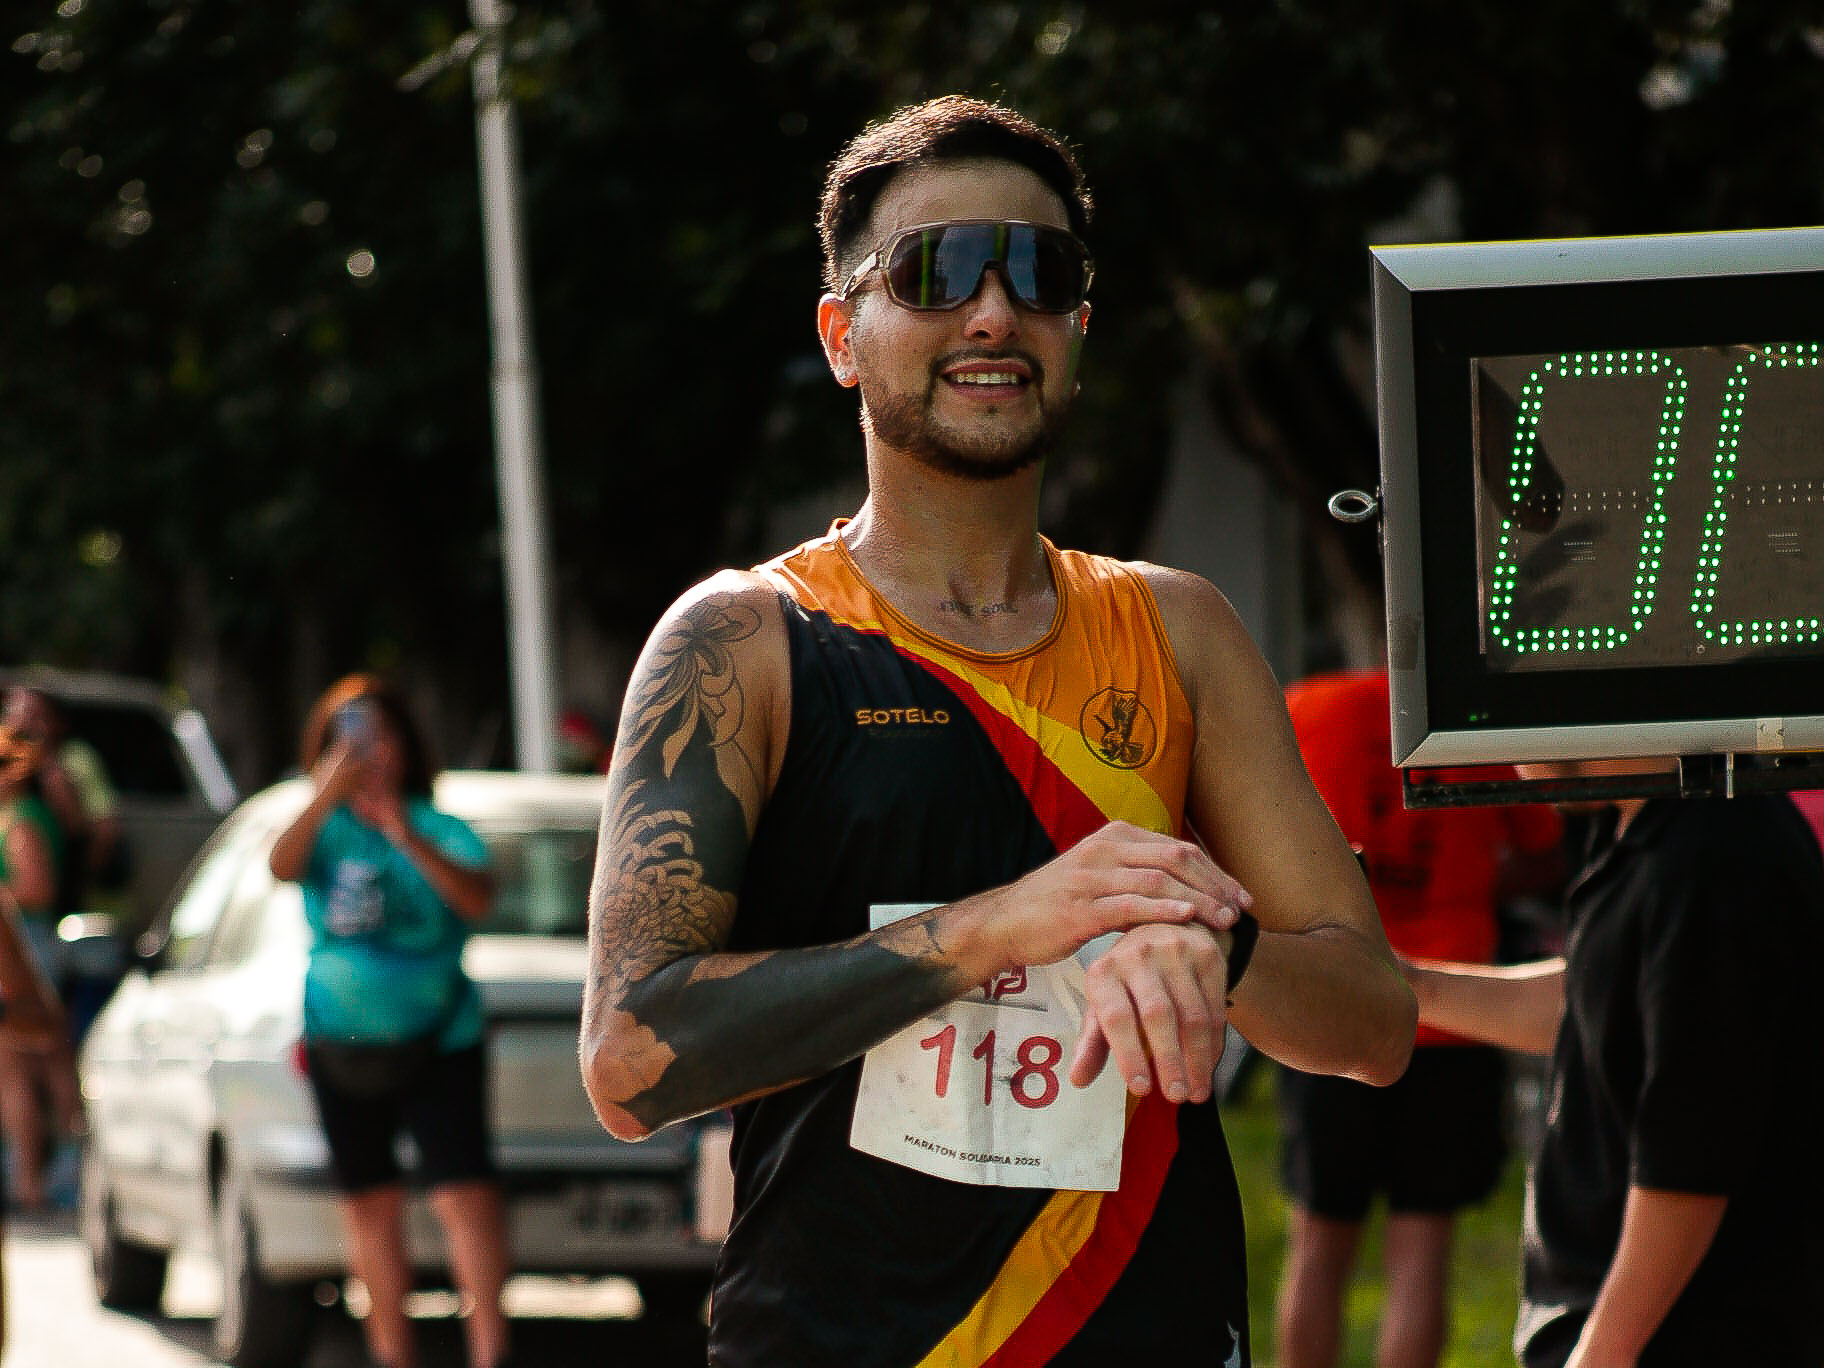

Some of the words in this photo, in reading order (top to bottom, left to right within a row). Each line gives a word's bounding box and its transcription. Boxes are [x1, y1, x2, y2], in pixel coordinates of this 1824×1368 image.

[855, 708, 950, 725] SOTELO
[919, 1023, 1063, 1109] 118
[903, 1134, 957, 1159] MARATON
[1013, 1156, 1041, 1167] 2025
